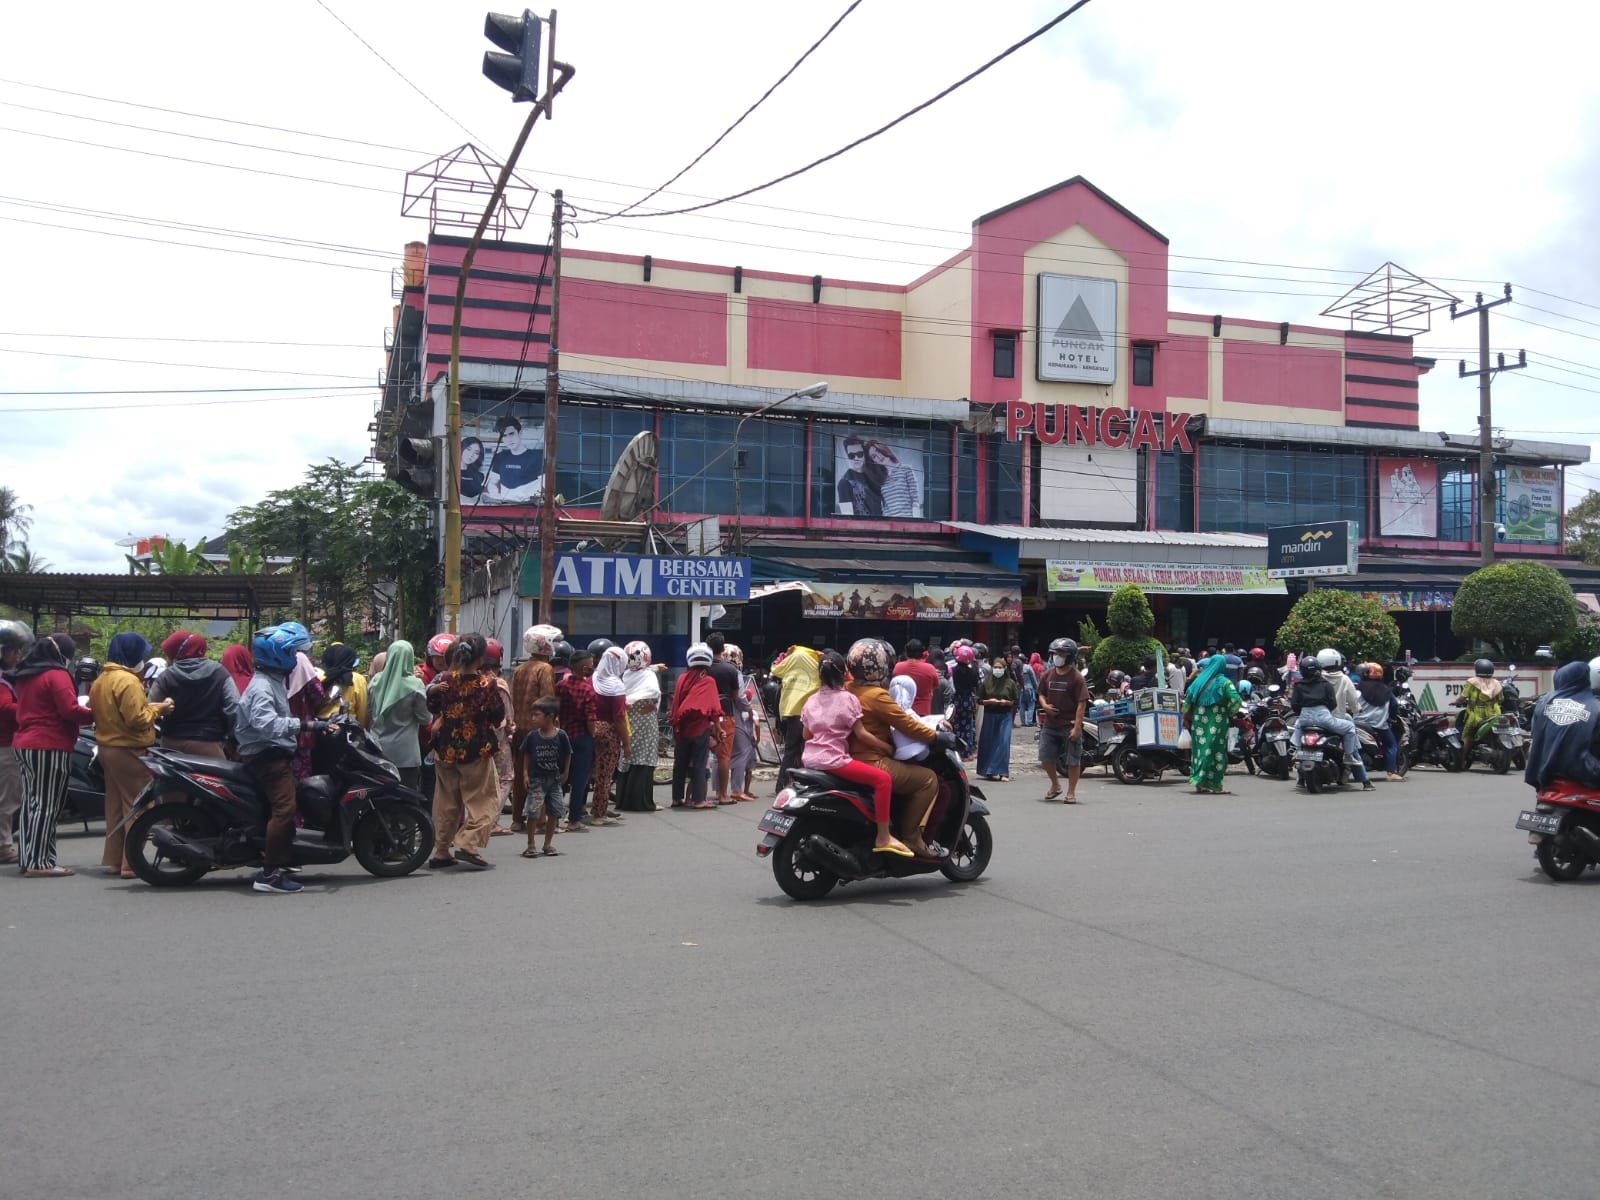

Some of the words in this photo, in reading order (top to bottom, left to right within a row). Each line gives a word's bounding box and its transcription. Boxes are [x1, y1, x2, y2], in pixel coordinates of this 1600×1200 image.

[1052, 339, 1104, 351] PUNCAK
[1059, 353, 1098, 363] HOTEL
[1006, 400, 1193, 453] PUNCAK
[1281, 538, 1321, 554] mandiri
[551, 556, 653, 595] ATM
[660, 559, 744, 578] BERSAMA
[1151, 569, 1172, 585] LEBIH
[667, 578, 736, 596] CENTER
